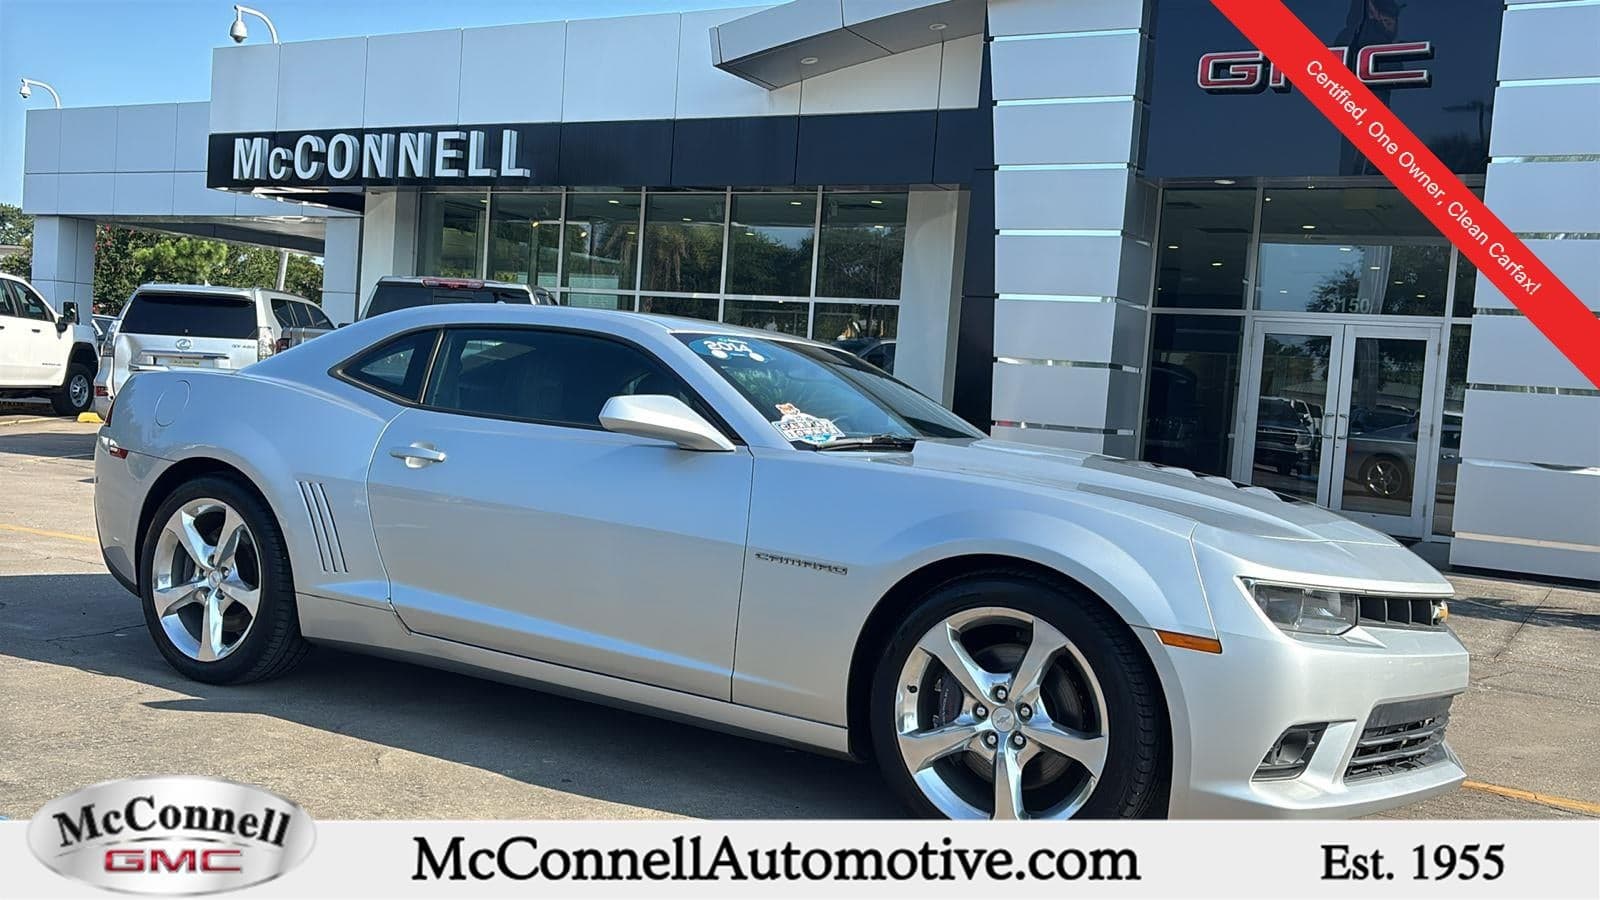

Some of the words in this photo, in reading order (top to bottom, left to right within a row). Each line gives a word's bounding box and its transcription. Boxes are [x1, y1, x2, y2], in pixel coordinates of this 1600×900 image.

[1197, 41, 1431, 89] GC
[233, 129, 531, 181] McCONNELL
[1326, 298, 1370, 313] 3150
[703, 340, 753, 354] 2014
